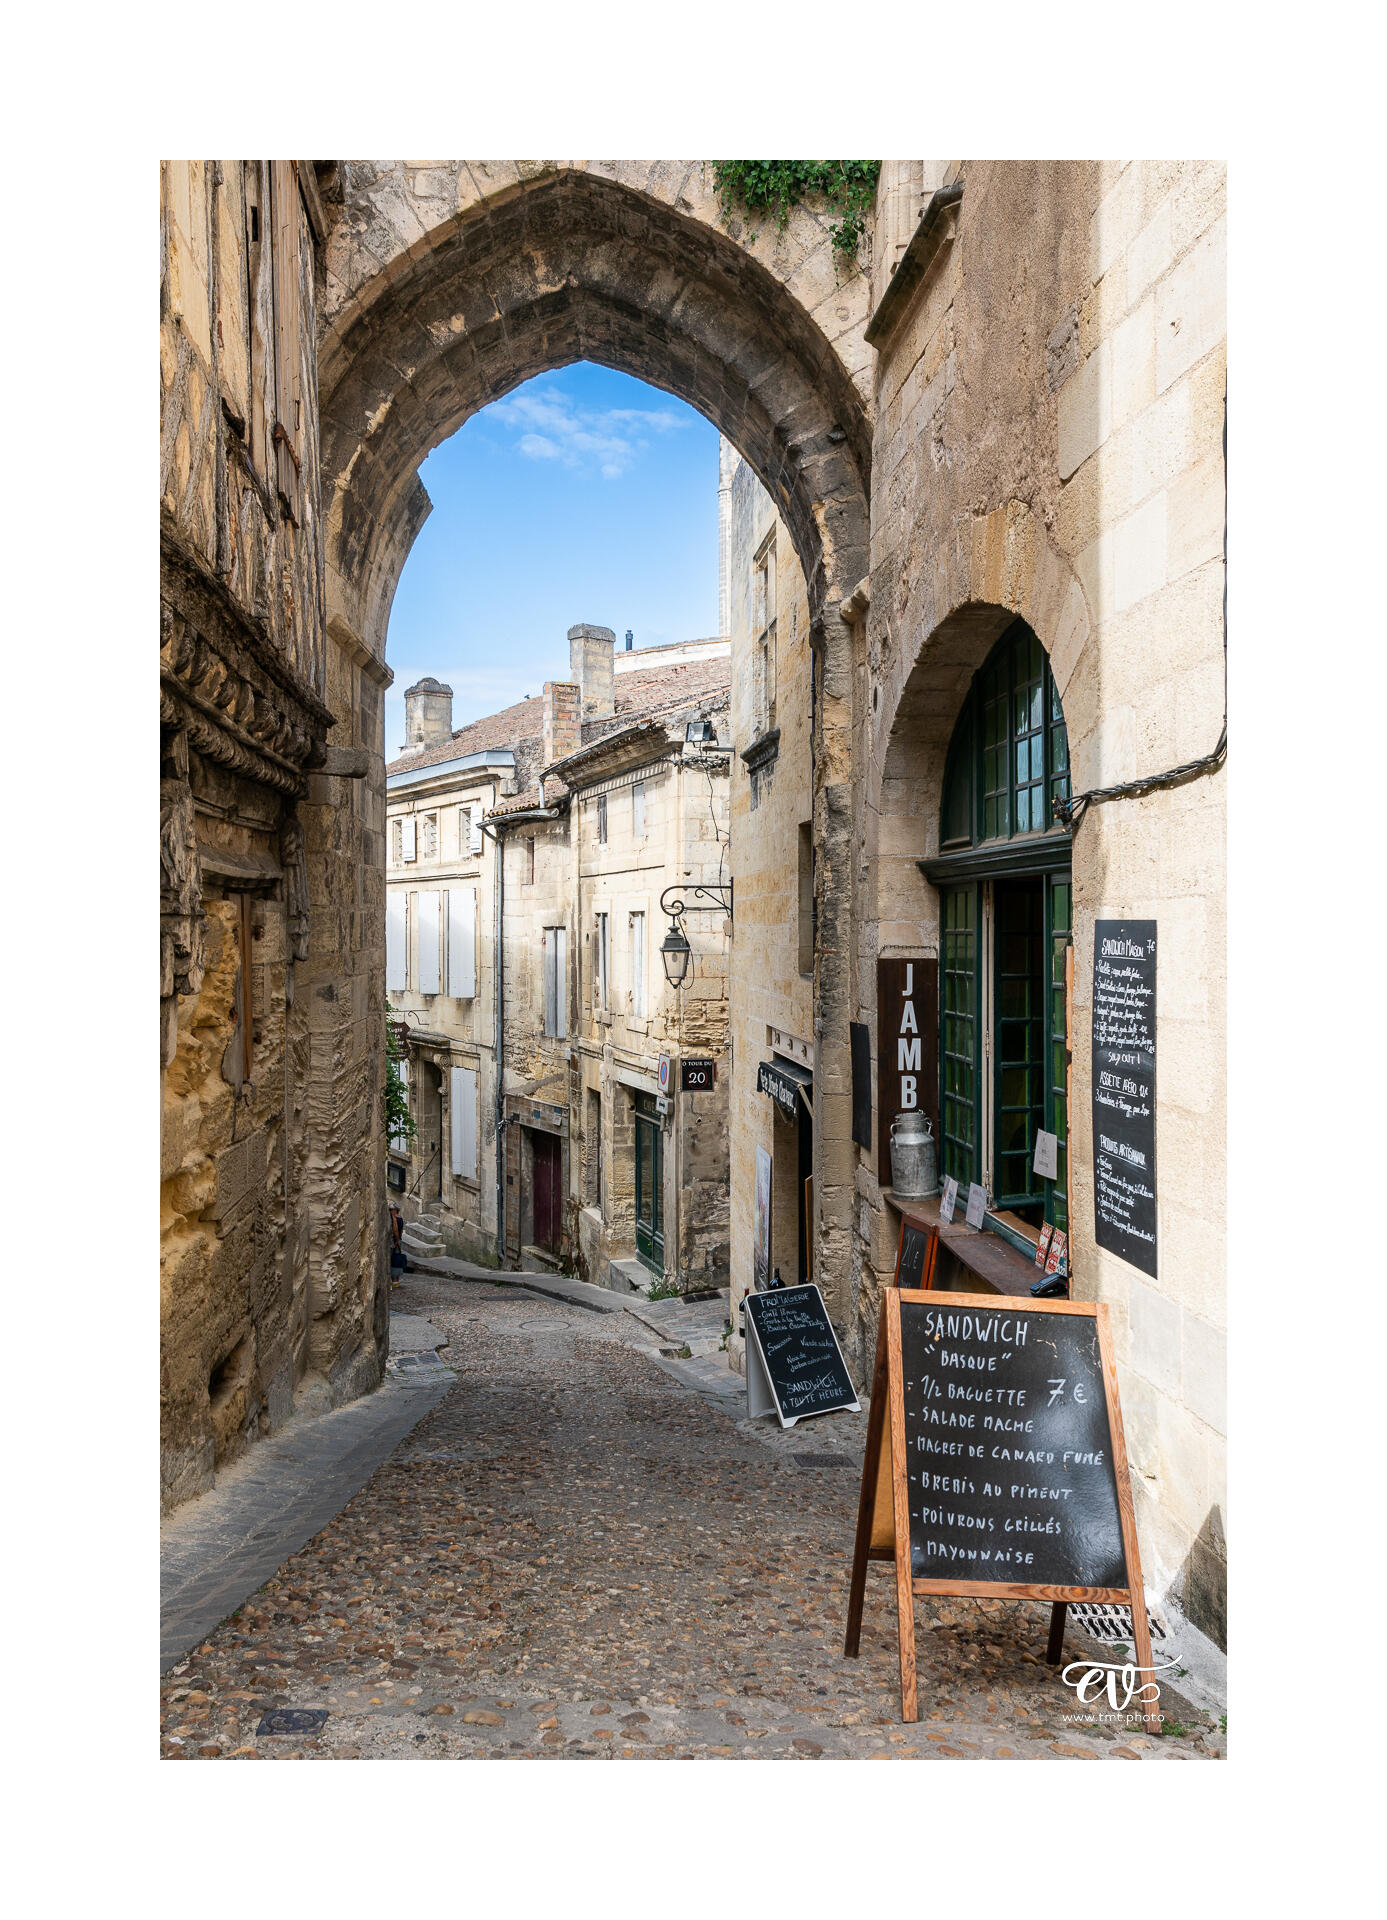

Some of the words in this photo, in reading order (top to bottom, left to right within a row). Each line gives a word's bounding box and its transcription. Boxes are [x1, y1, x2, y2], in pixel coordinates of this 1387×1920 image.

[688, 1072, 706, 1084] 20
[819, 1386, 844, 1401] HEURE
[948, 1383, 1027, 1407] BAGUETTE
[922, 1406, 976, 1428] SALADE
[917, 1435, 964, 1457] MAGRET
[968, 1445, 984, 1458] DE
[991, 1446, 1054, 1464] CANARD
[1063, 1450, 1104, 1466] FUMÉ
[982, 1482, 1002, 1497] AU
[1010, 1483, 1073, 1500] PIMENT
[922, 1505, 995, 1532] POIVRONS
[927, 1540, 1034, 1564] MAYONNAISE
